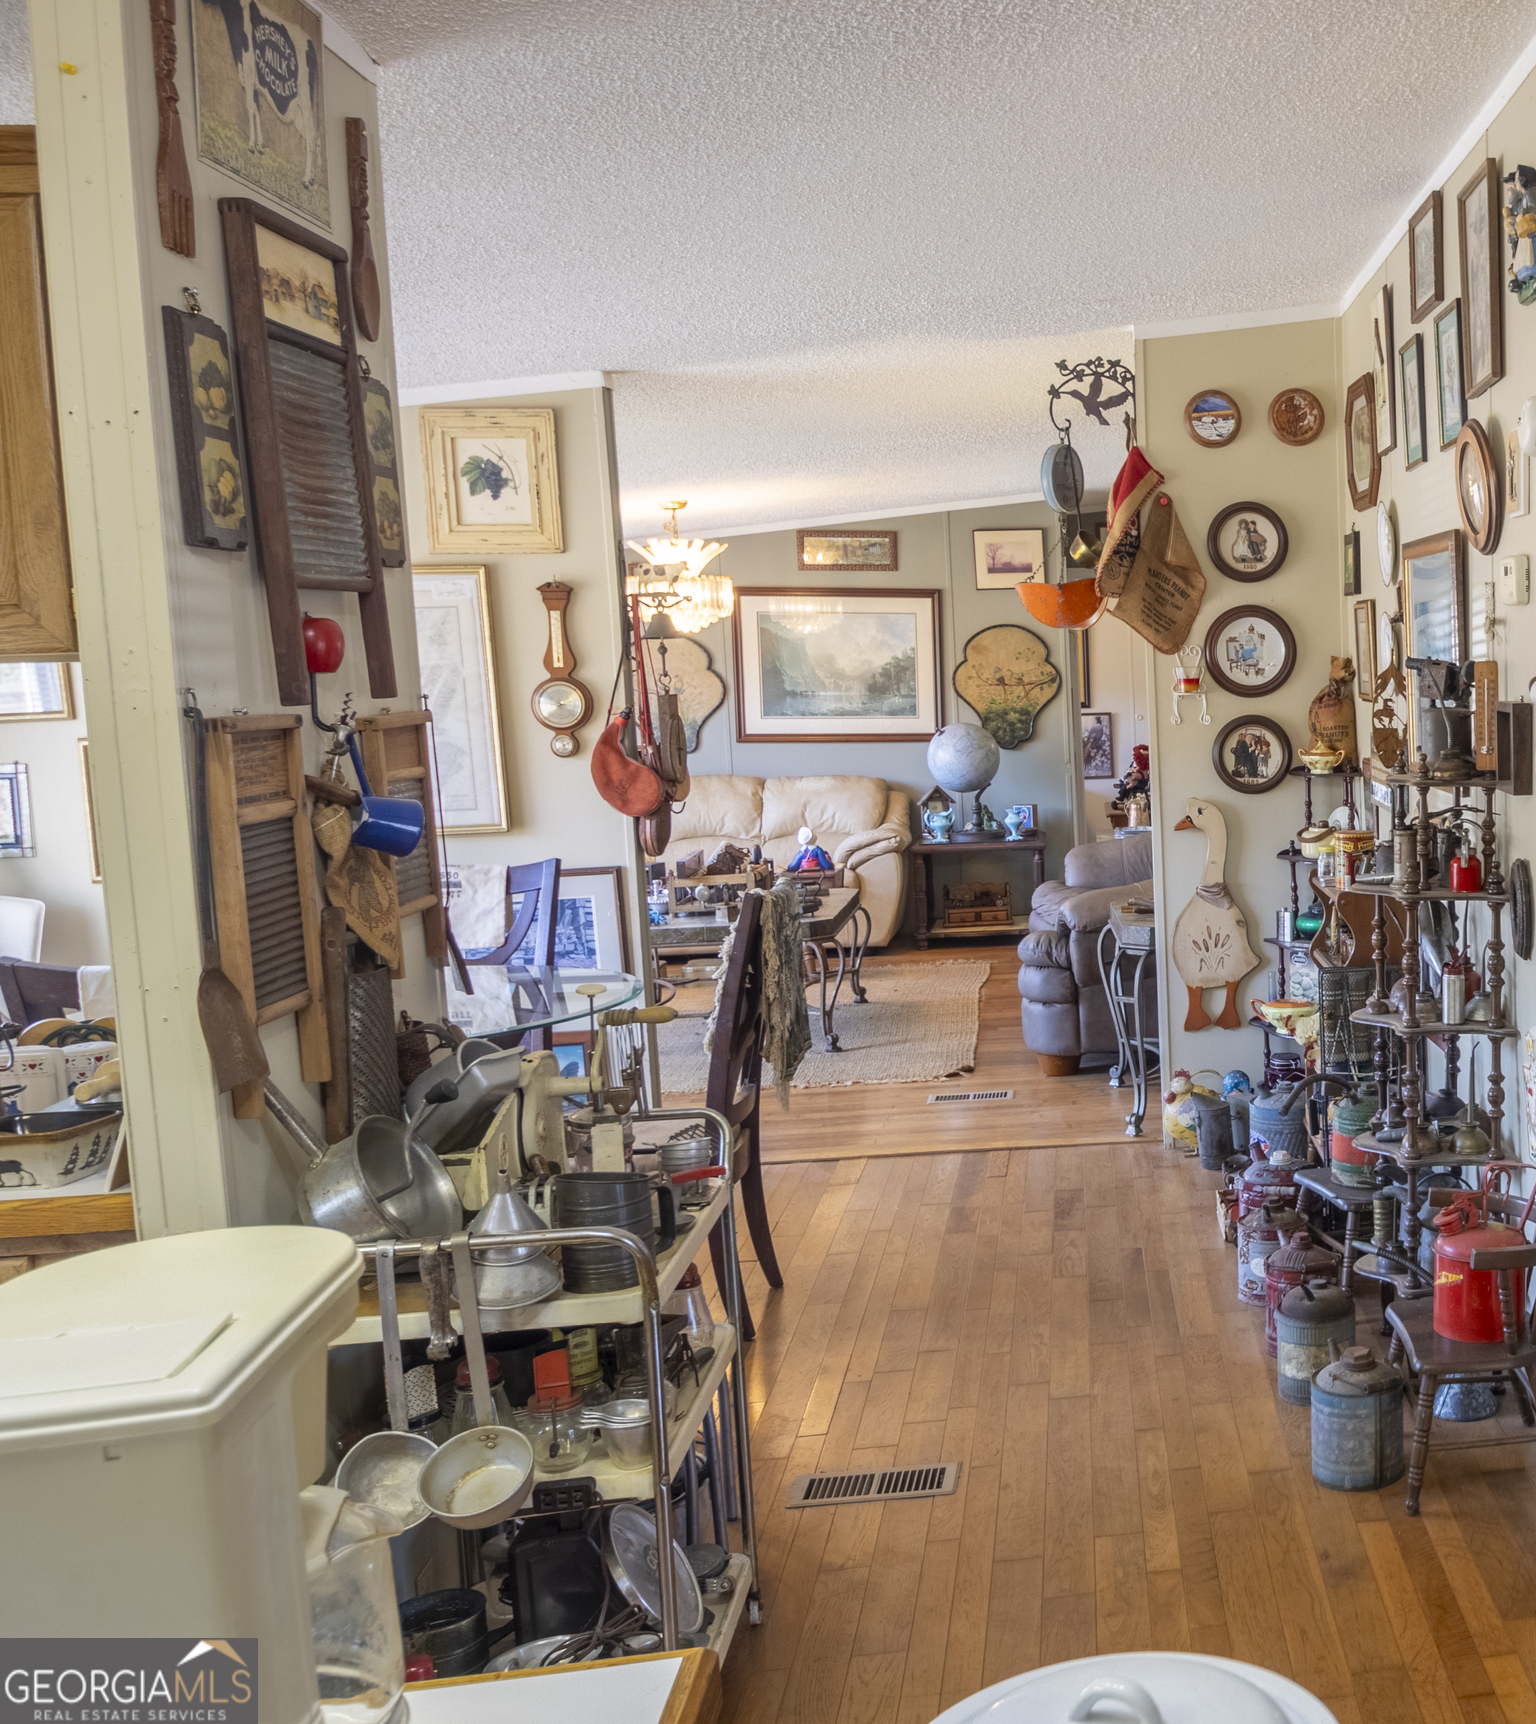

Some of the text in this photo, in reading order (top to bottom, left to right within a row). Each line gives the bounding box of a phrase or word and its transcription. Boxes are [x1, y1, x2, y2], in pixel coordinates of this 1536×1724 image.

[255, 23, 297, 72] HERSHEY'S
[254, 48, 298, 98] CHOCOLATE
[264, 44, 289, 80] MILK
[1155, 582, 1175, 599] CENTER
[1171, 580, 1190, 601] PEANUT
[1318, 731, 1350, 739] PEANUTS
